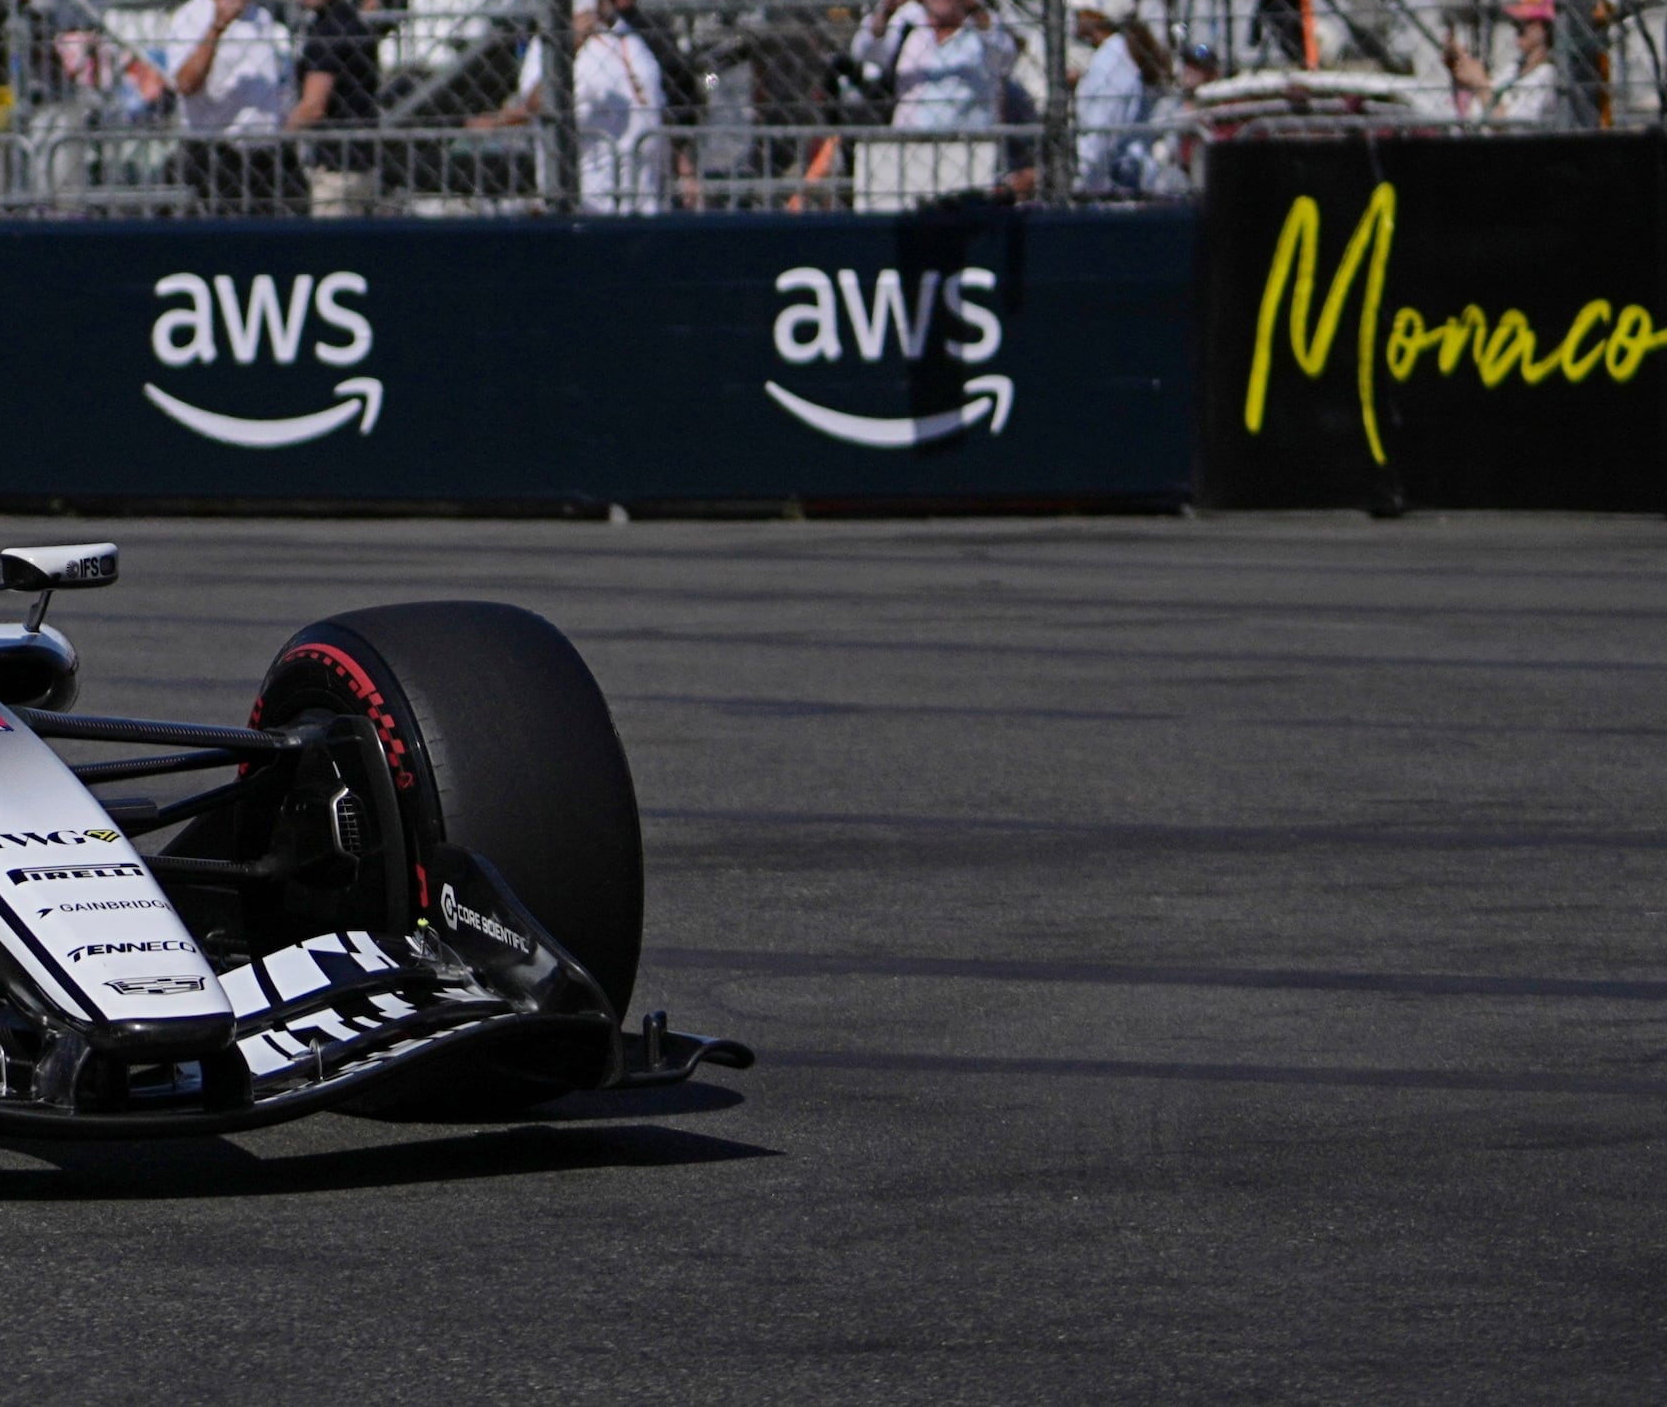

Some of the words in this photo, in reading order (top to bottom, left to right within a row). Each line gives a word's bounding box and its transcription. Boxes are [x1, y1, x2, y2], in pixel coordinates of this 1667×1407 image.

[152, 270, 372, 365] aws
[773, 266, 1002, 363] aws
[1245, 182, 1667, 466] Monaco
[80, 557, 100, 577] IFS
[7, 863, 144, 886] PIRELLI
[457, 904, 481, 930] CORE
[67, 941, 196, 962] TENNECO
